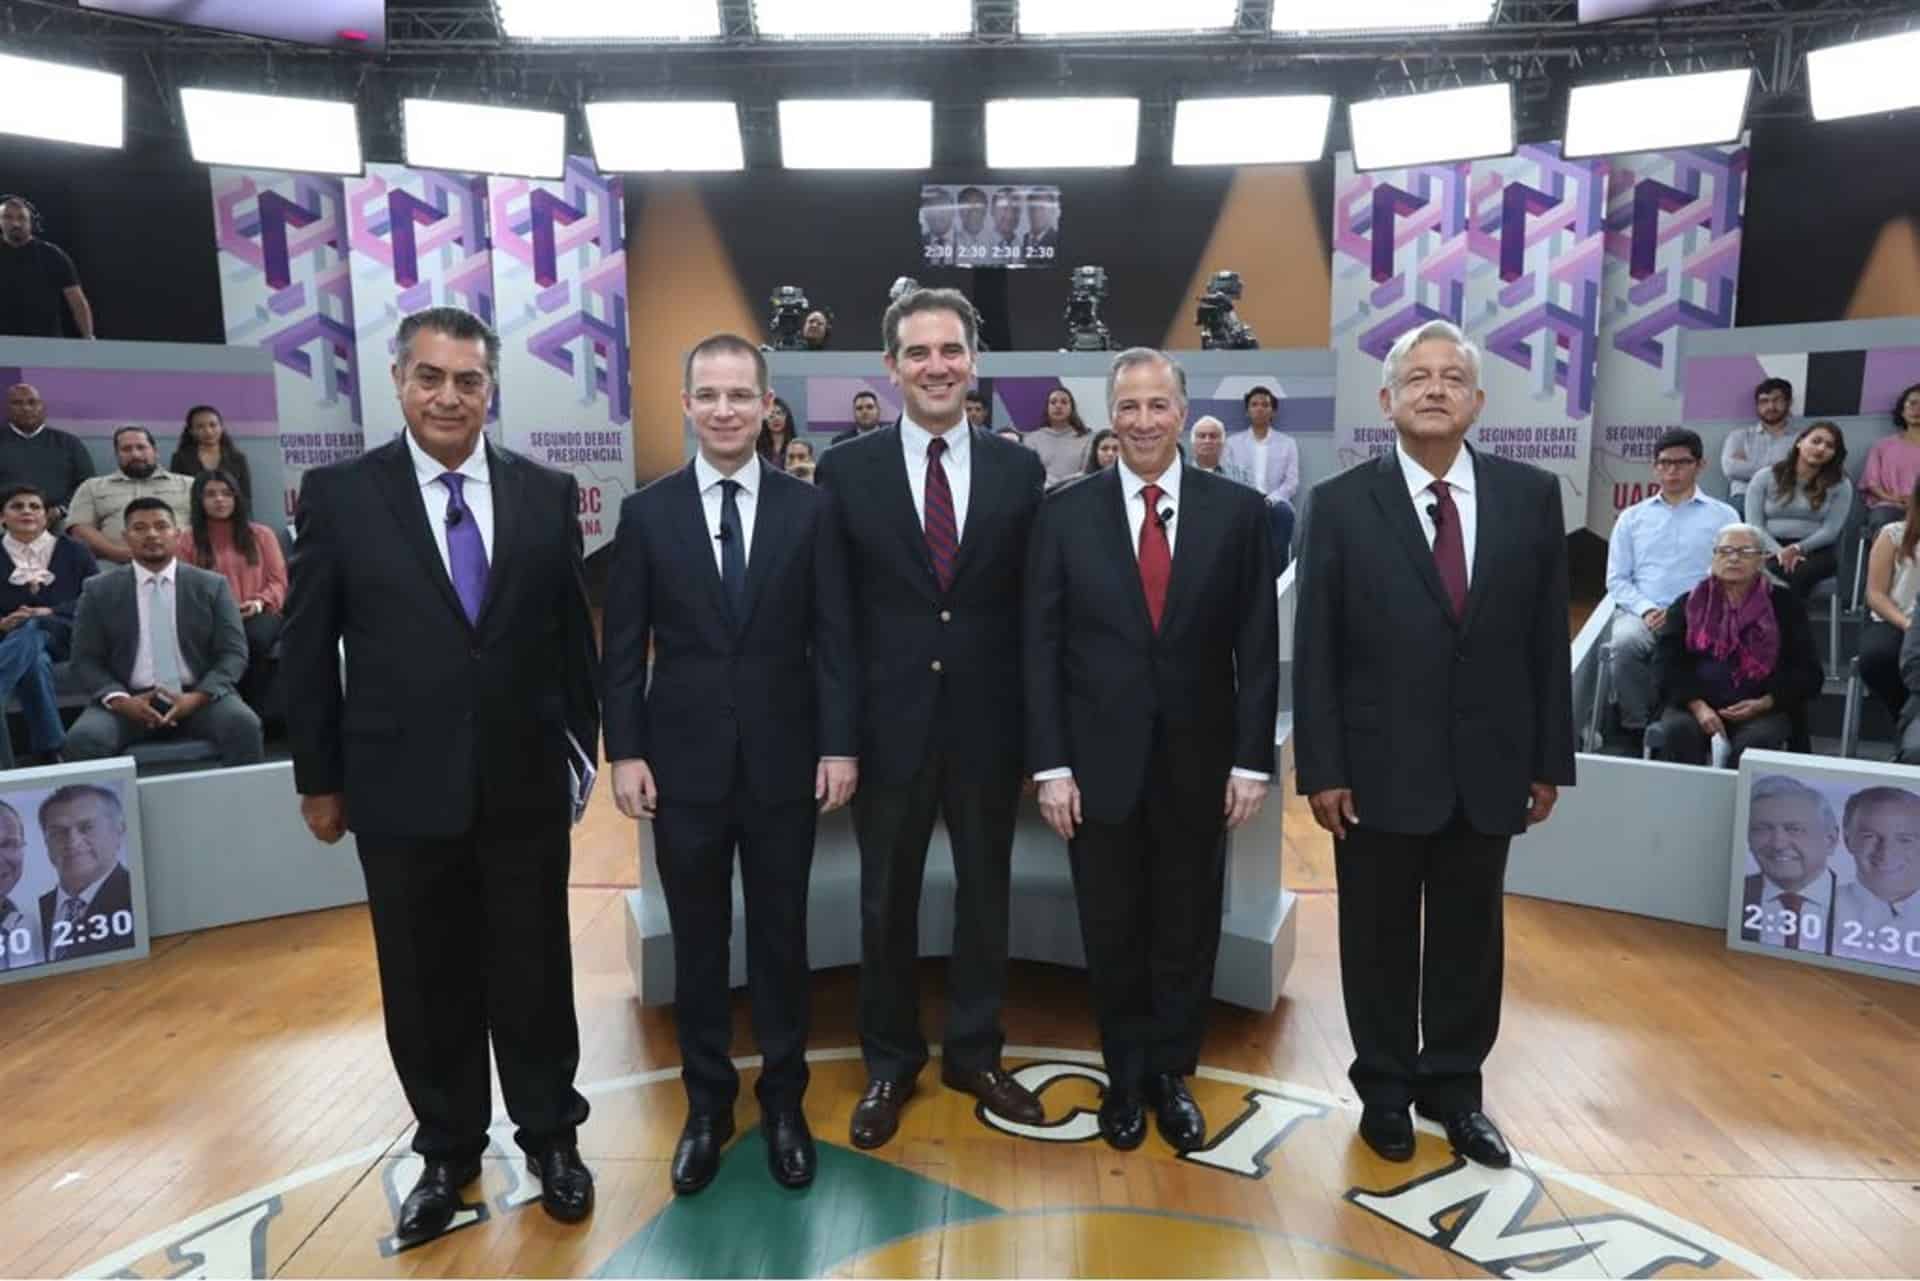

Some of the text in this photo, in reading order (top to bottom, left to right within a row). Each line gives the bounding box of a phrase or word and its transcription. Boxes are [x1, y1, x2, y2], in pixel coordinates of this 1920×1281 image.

[957, 246, 986, 258] 2:30
[1025, 246, 1055, 258] 2:30
[280, 433, 321, 448] GUNDO
[530, 432, 622, 447] SEGUNDO DEBATE
[1354, 428, 1397, 442] SEGUND
[1480, 427, 1577, 442] SEGUNDO DEBATE
[547, 448, 623, 463] PRESIDENCIAL
[1495, 444, 1576, 459] PRESIDENCIAL
[577, 487, 602, 513] BC
[53, 910, 133, 948] 2:30
[1743, 904, 1822, 940] 2:30
